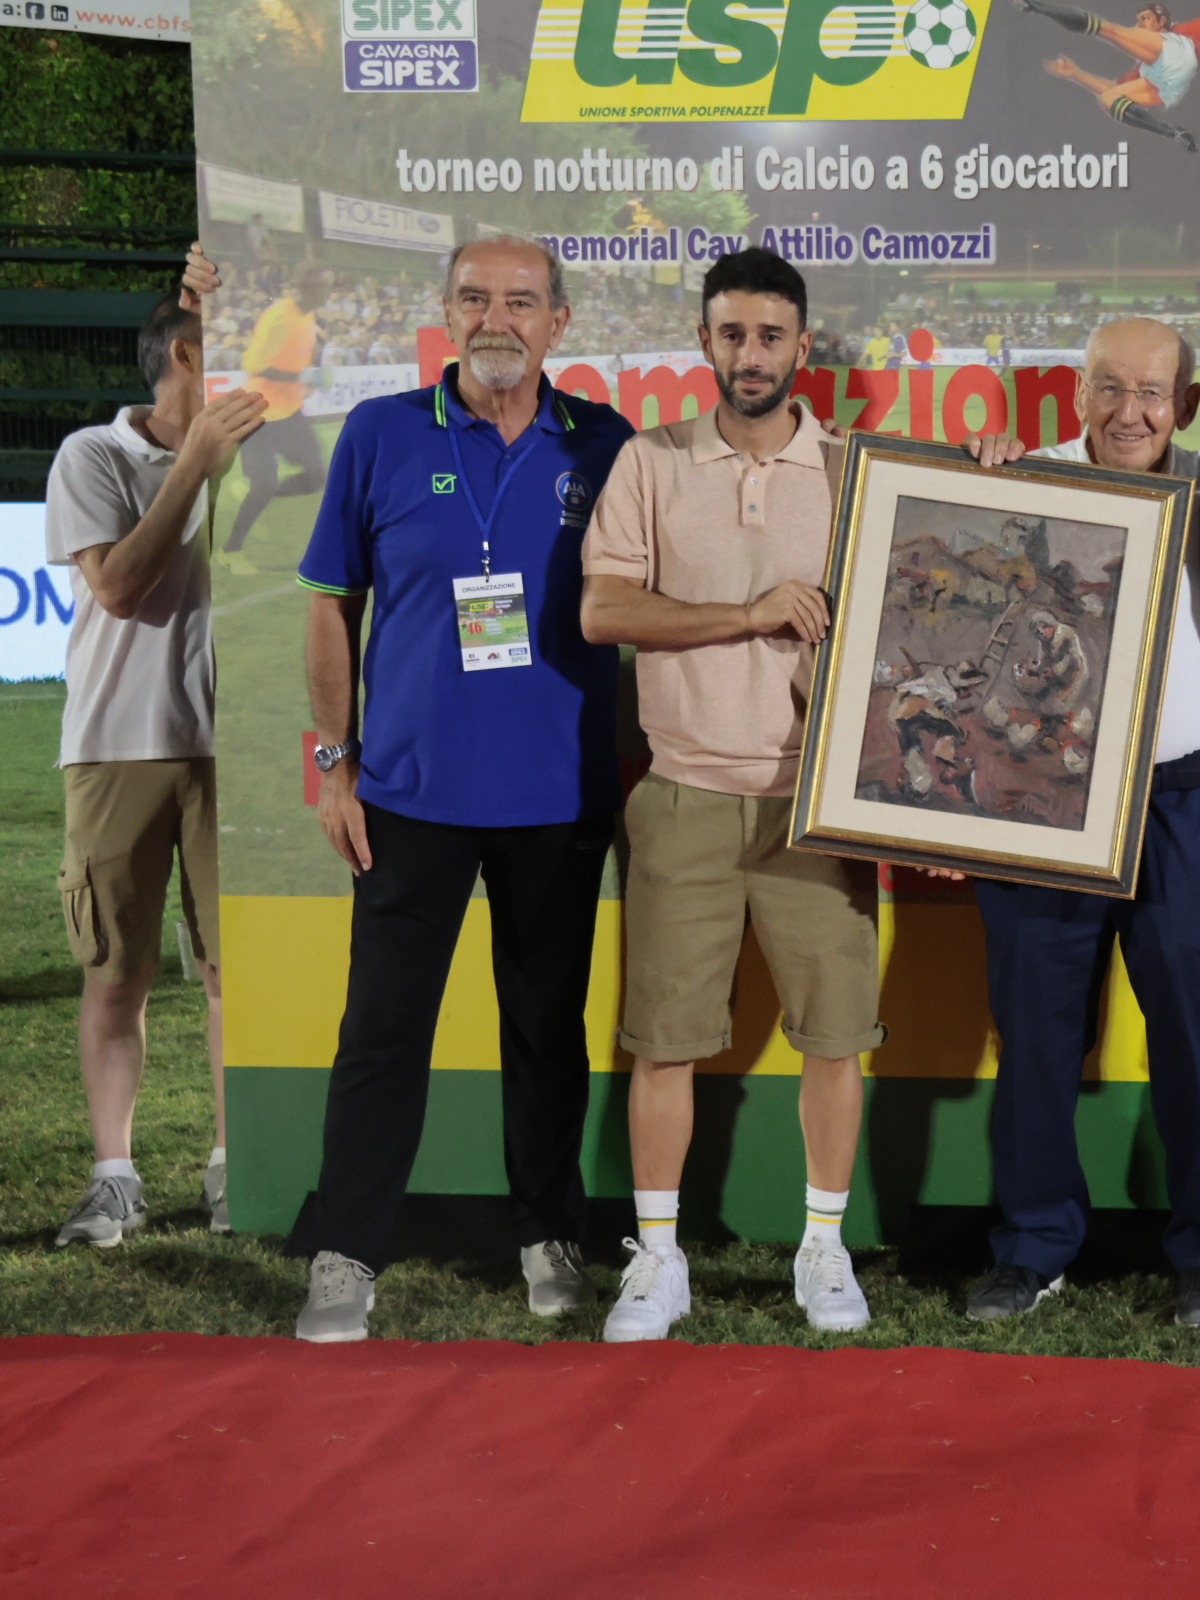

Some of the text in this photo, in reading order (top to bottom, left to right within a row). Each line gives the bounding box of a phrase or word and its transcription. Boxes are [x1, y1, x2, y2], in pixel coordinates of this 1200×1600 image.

[352, 0, 463, 31] SIPEX
[359, 44, 460, 58] CAVAGNA
[359, 60, 461, 86] SIPEX
[579, 106, 766, 117] UNIONE SPORTIVA POLPENAZZE
[397, 142, 1128, 199] torneo notturno di Calcio a 6 giocatori
[761, 228, 854, 260] Attilio
[862, 226, 990, 259] Camozzi
[461, 582, 516, 593] ORGANIZZAZIONE
[467, 621, 483, 635] 46
